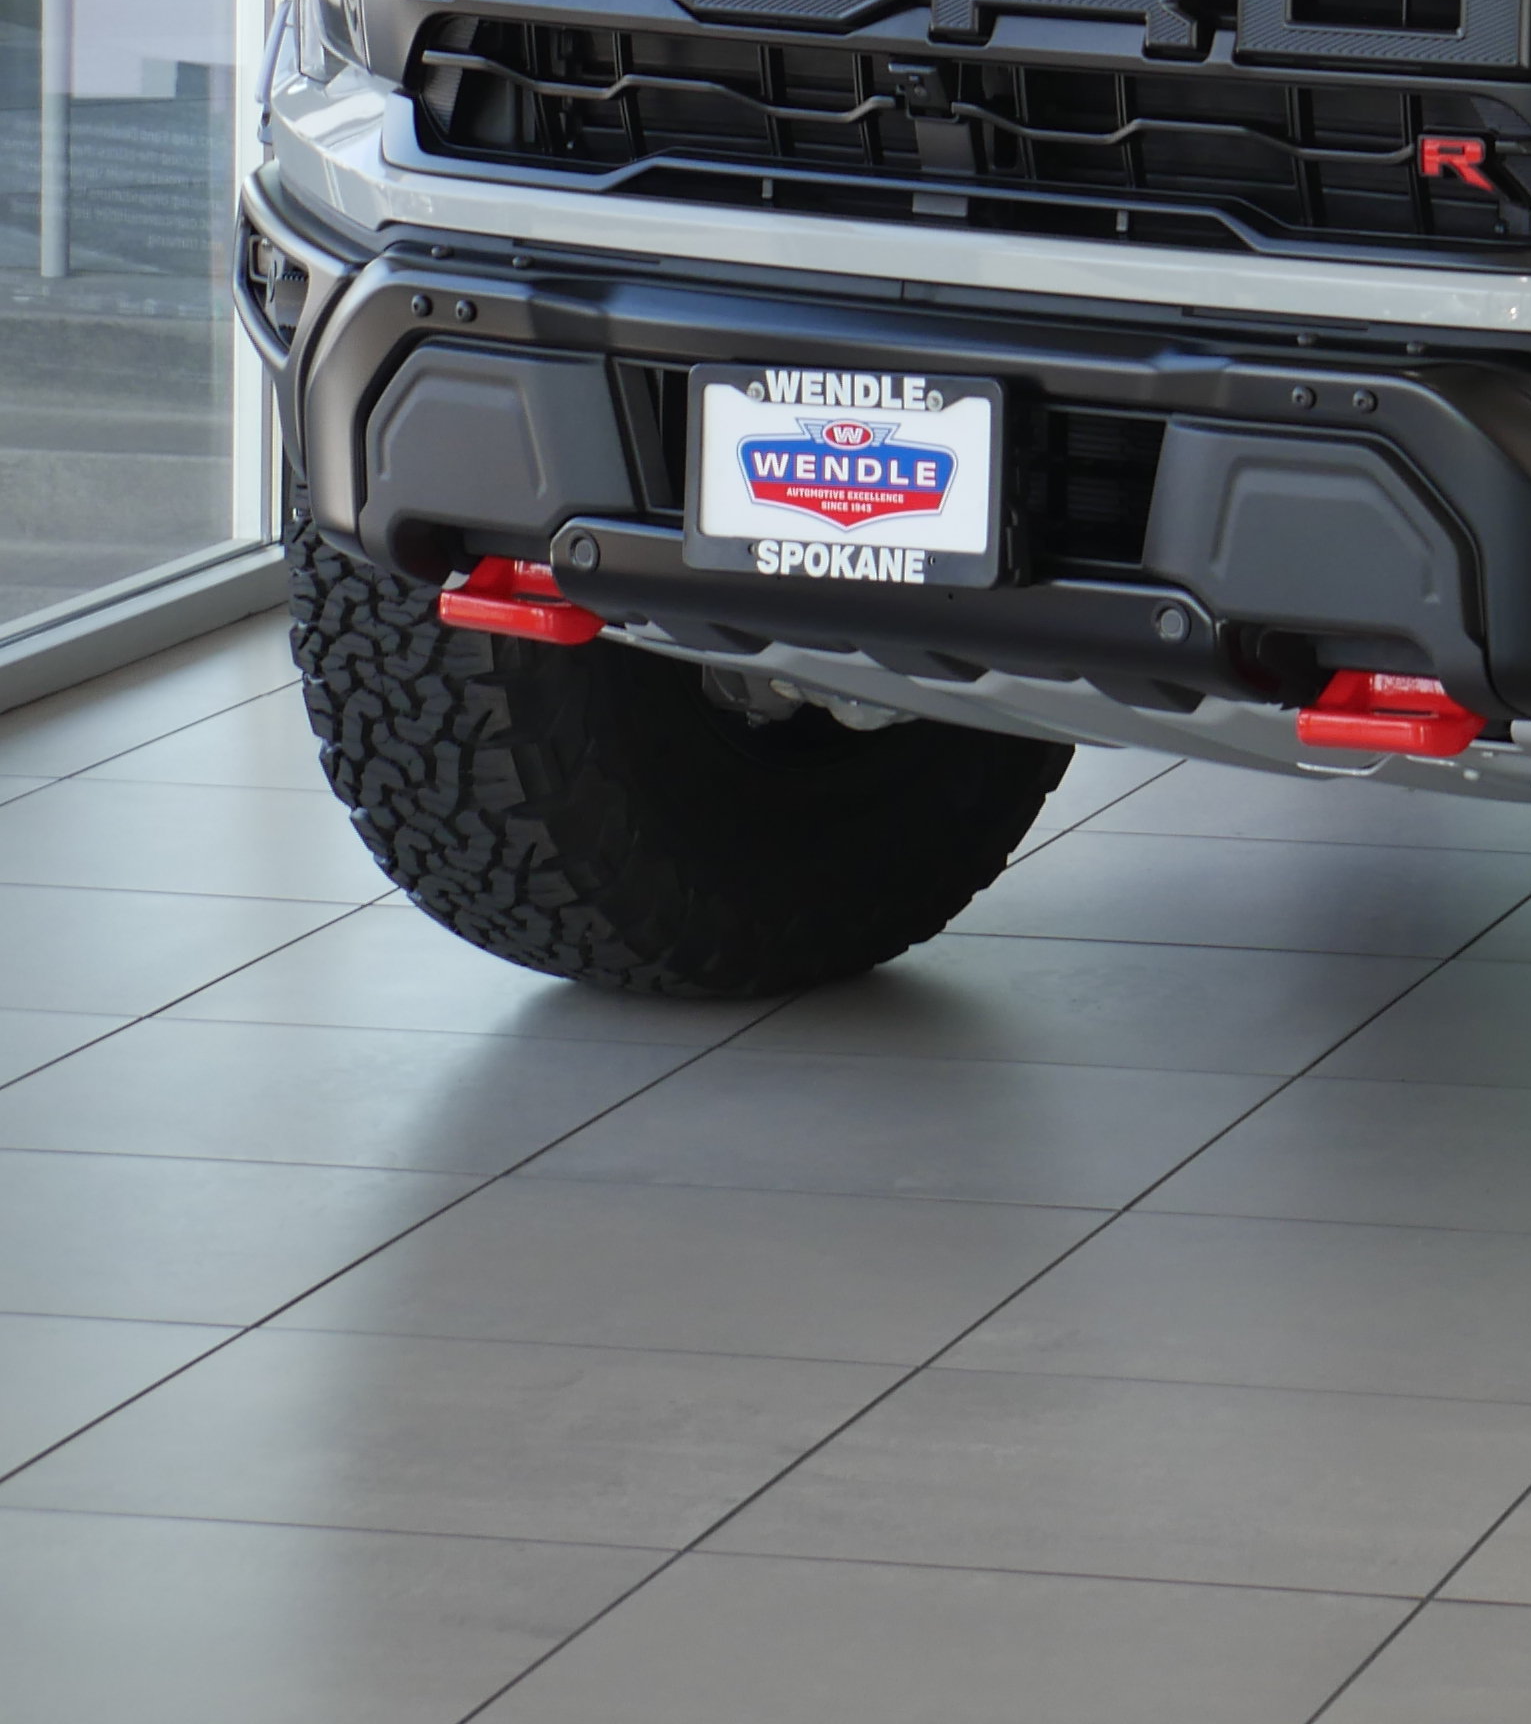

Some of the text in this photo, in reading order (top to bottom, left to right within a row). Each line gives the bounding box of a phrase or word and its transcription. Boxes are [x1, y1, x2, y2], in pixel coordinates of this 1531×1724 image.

[1420, 135, 1493, 192] R
[766, 369, 926, 411] WENDLE
[833, 427, 862, 445] W
[752, 451, 937, 487] WENDLE
[786, 487, 905, 504] AUTOMOTIVE EXCELLENCE
[821, 500, 849, 512] SINCE
[756, 540, 925, 584] SPOKANE
